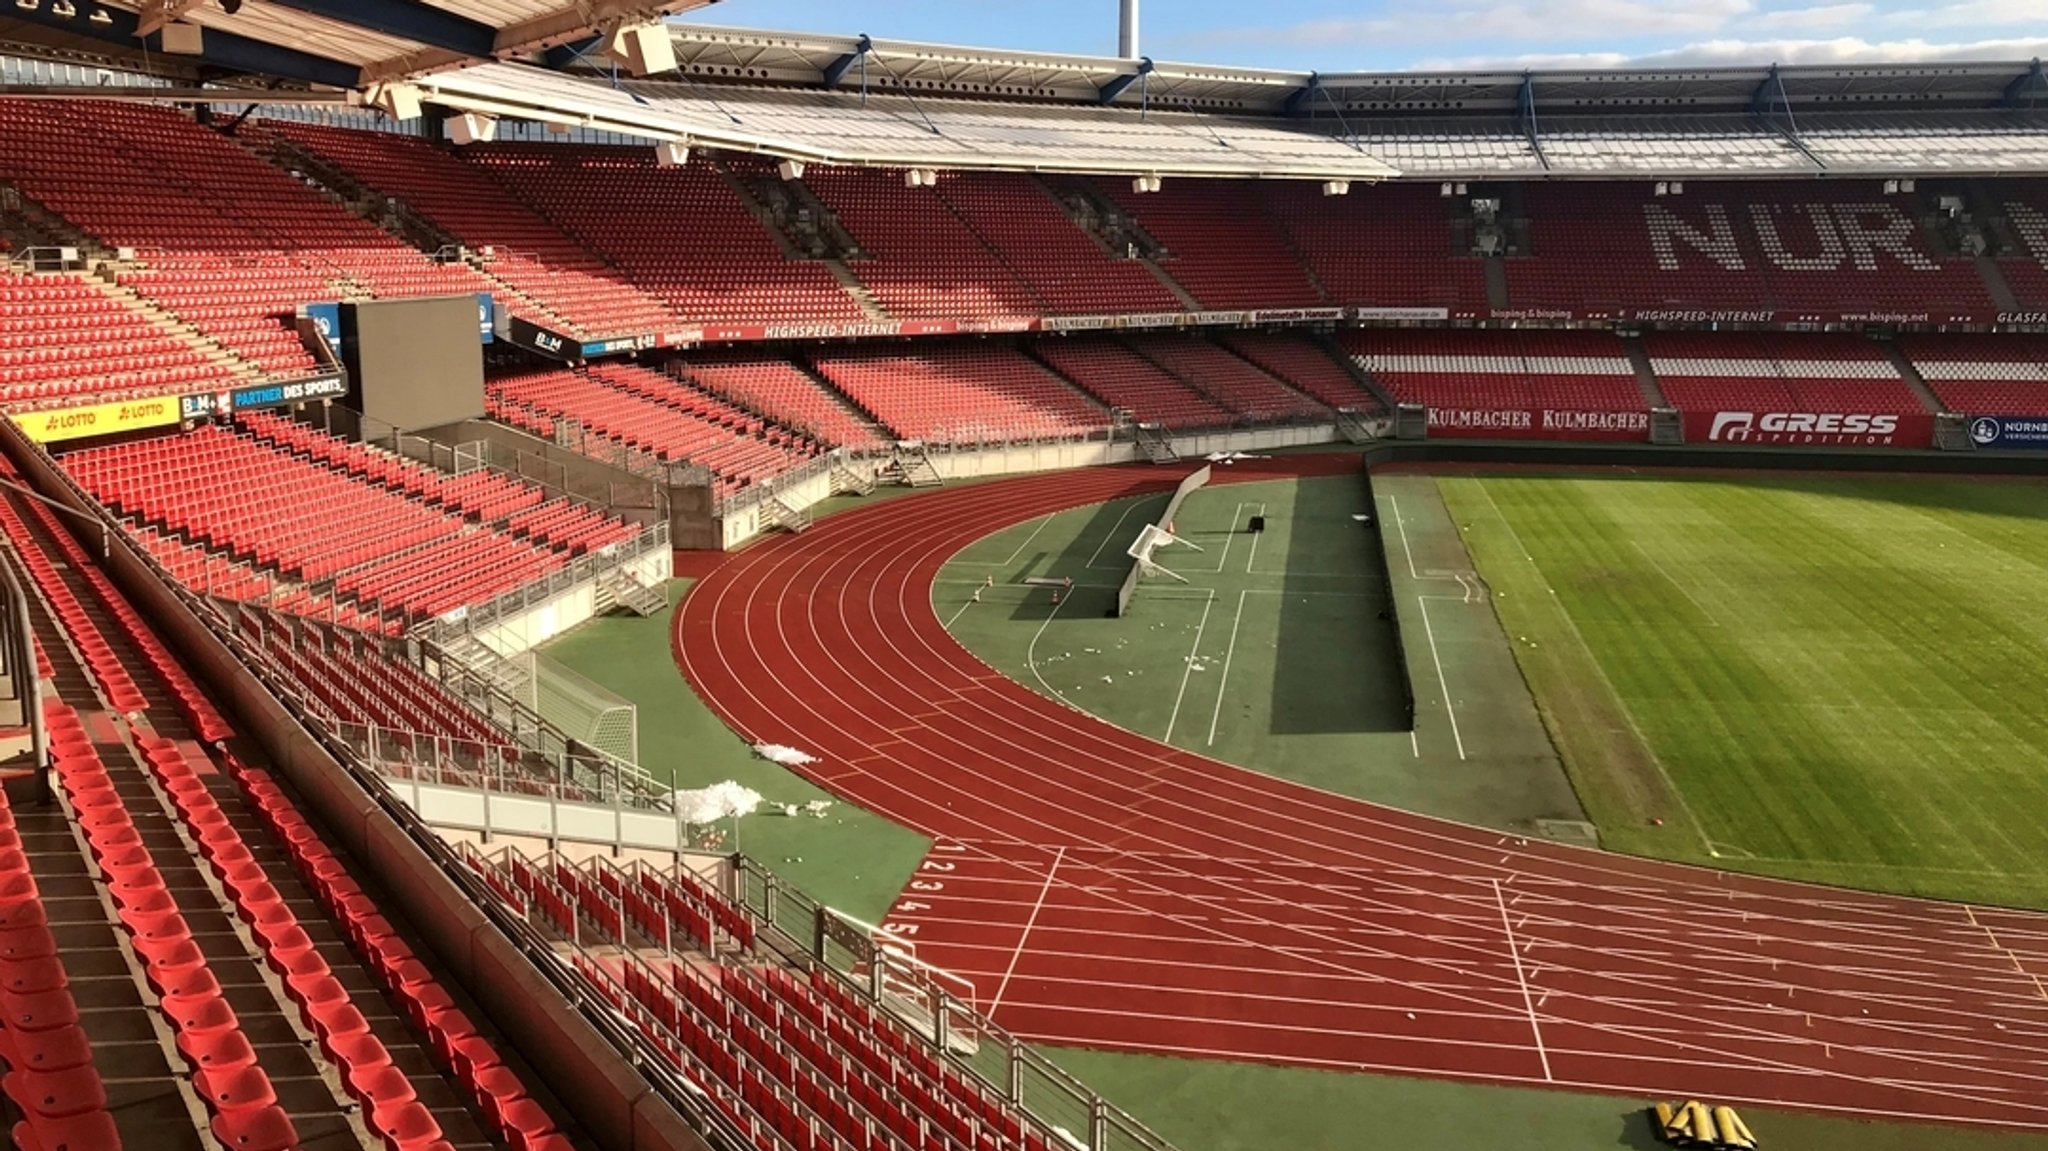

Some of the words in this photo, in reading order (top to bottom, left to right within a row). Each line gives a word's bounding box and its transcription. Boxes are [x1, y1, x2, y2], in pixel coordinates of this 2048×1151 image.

[1635, 310, 1774, 322] HIGHSPEED-INTERNET
[1841, 311, 1929, 323] www.bisping.net
[764, 322, 902, 338] HIGHSPEED-INTERNET
[235, 386, 282, 407] PARTNER
[283, 382, 303, 400] DES
[132, 403, 164, 418] LOTTO
[60, 412, 96, 428] LOTTO
[1428, 407, 1532, 427] KULMBACHER
[1543, 409, 1649, 429] KULMBACHER
[1759, 412, 1899, 434] GRESS
[1755, 433, 1893, 445] SPEDITION
[922, 861, 955, 871] 2
[911, 881, 943, 891] 3
[897, 901, 931, 911] 4
[883, 923, 919, 934] 5
